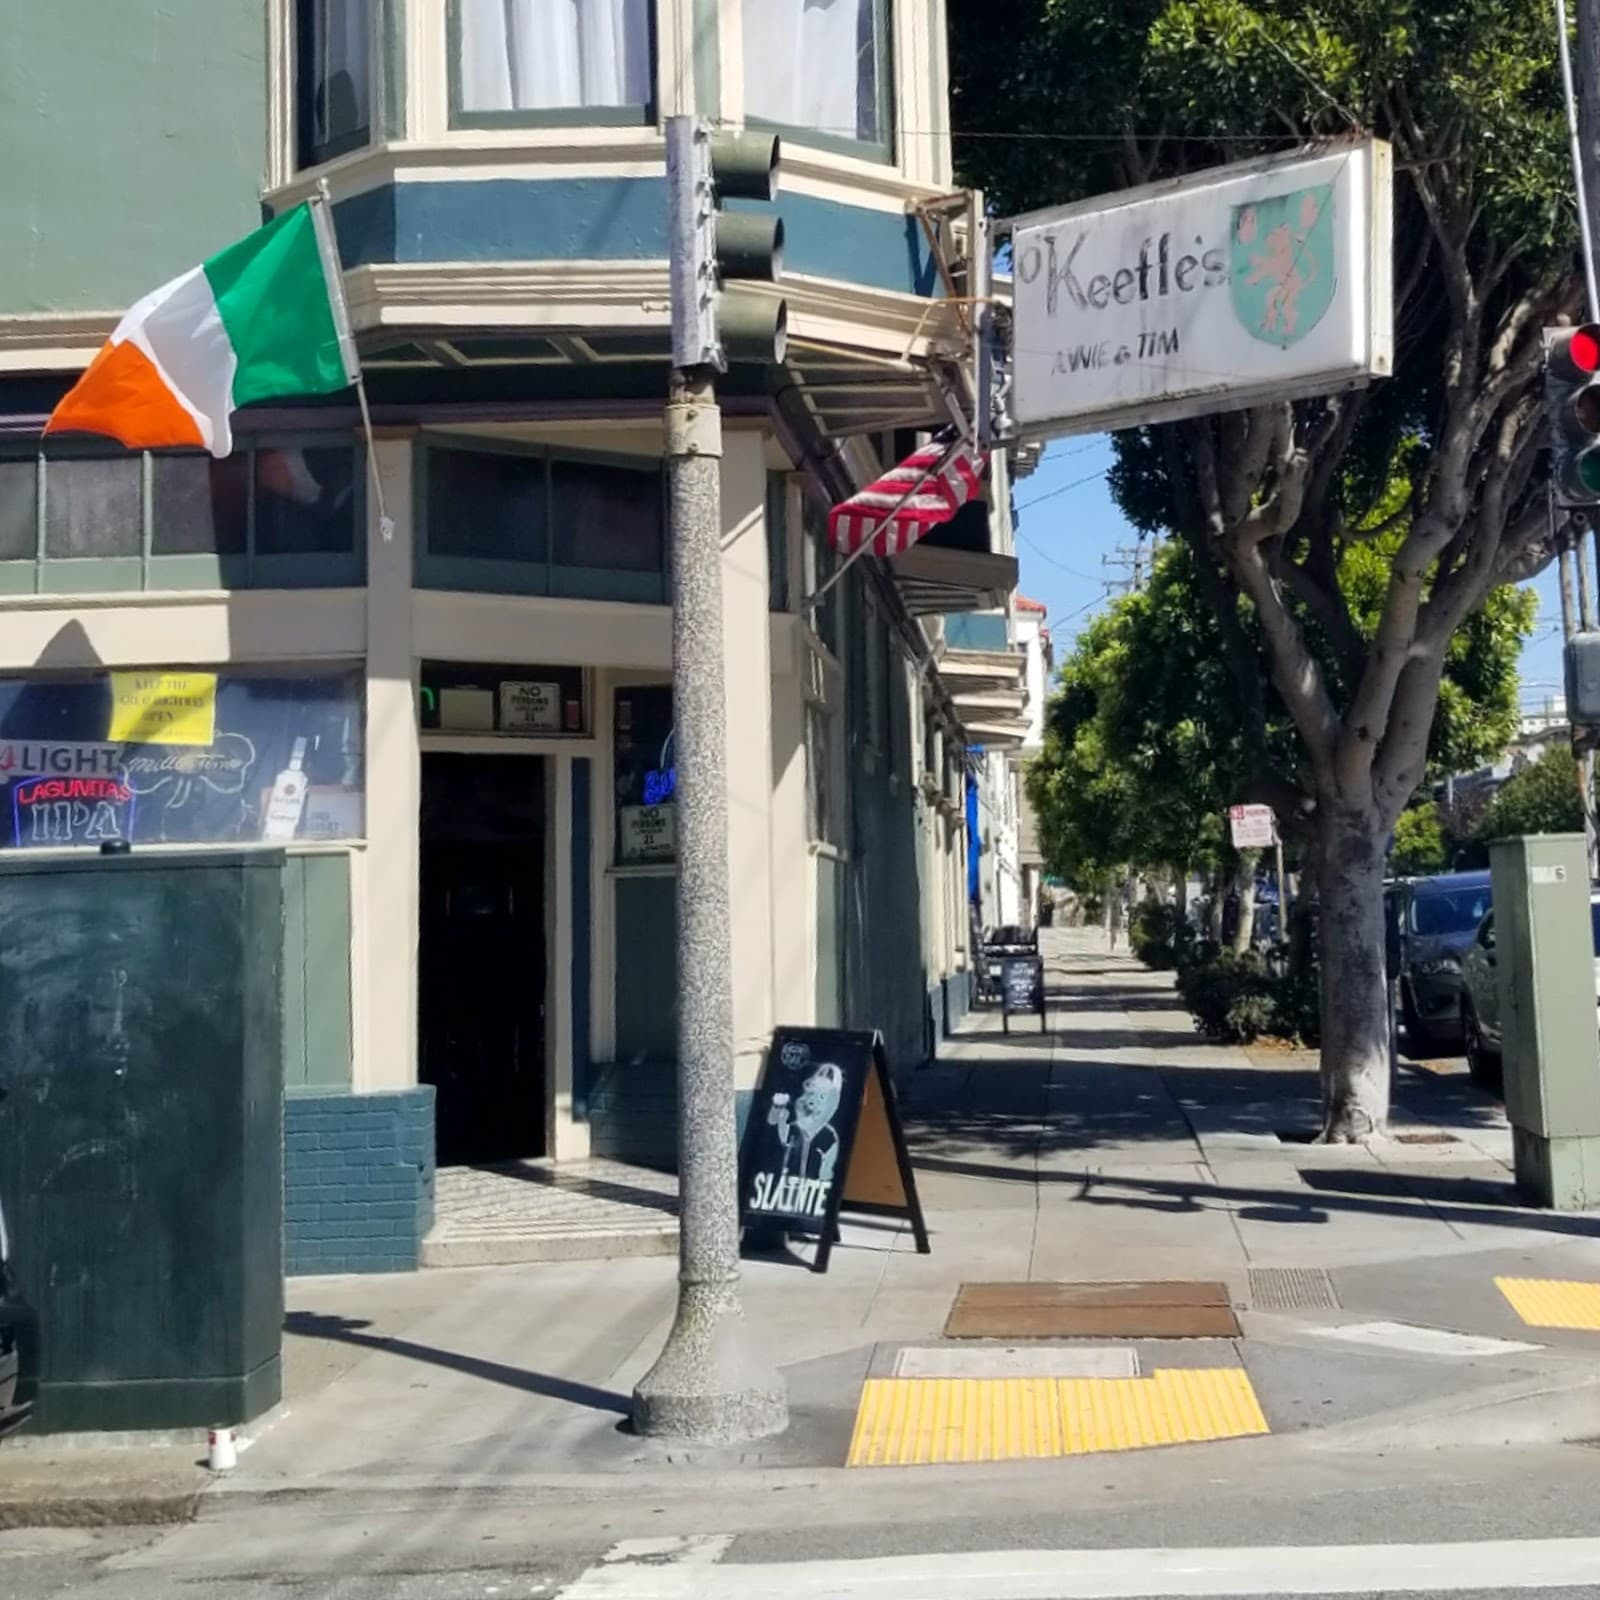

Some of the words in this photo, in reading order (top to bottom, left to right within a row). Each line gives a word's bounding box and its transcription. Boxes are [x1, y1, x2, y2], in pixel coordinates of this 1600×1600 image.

[1137, 327, 1179, 359] TIM
[22, 747, 118, 773] LIGHT
[19, 779, 132, 805] LAGUNITAS
